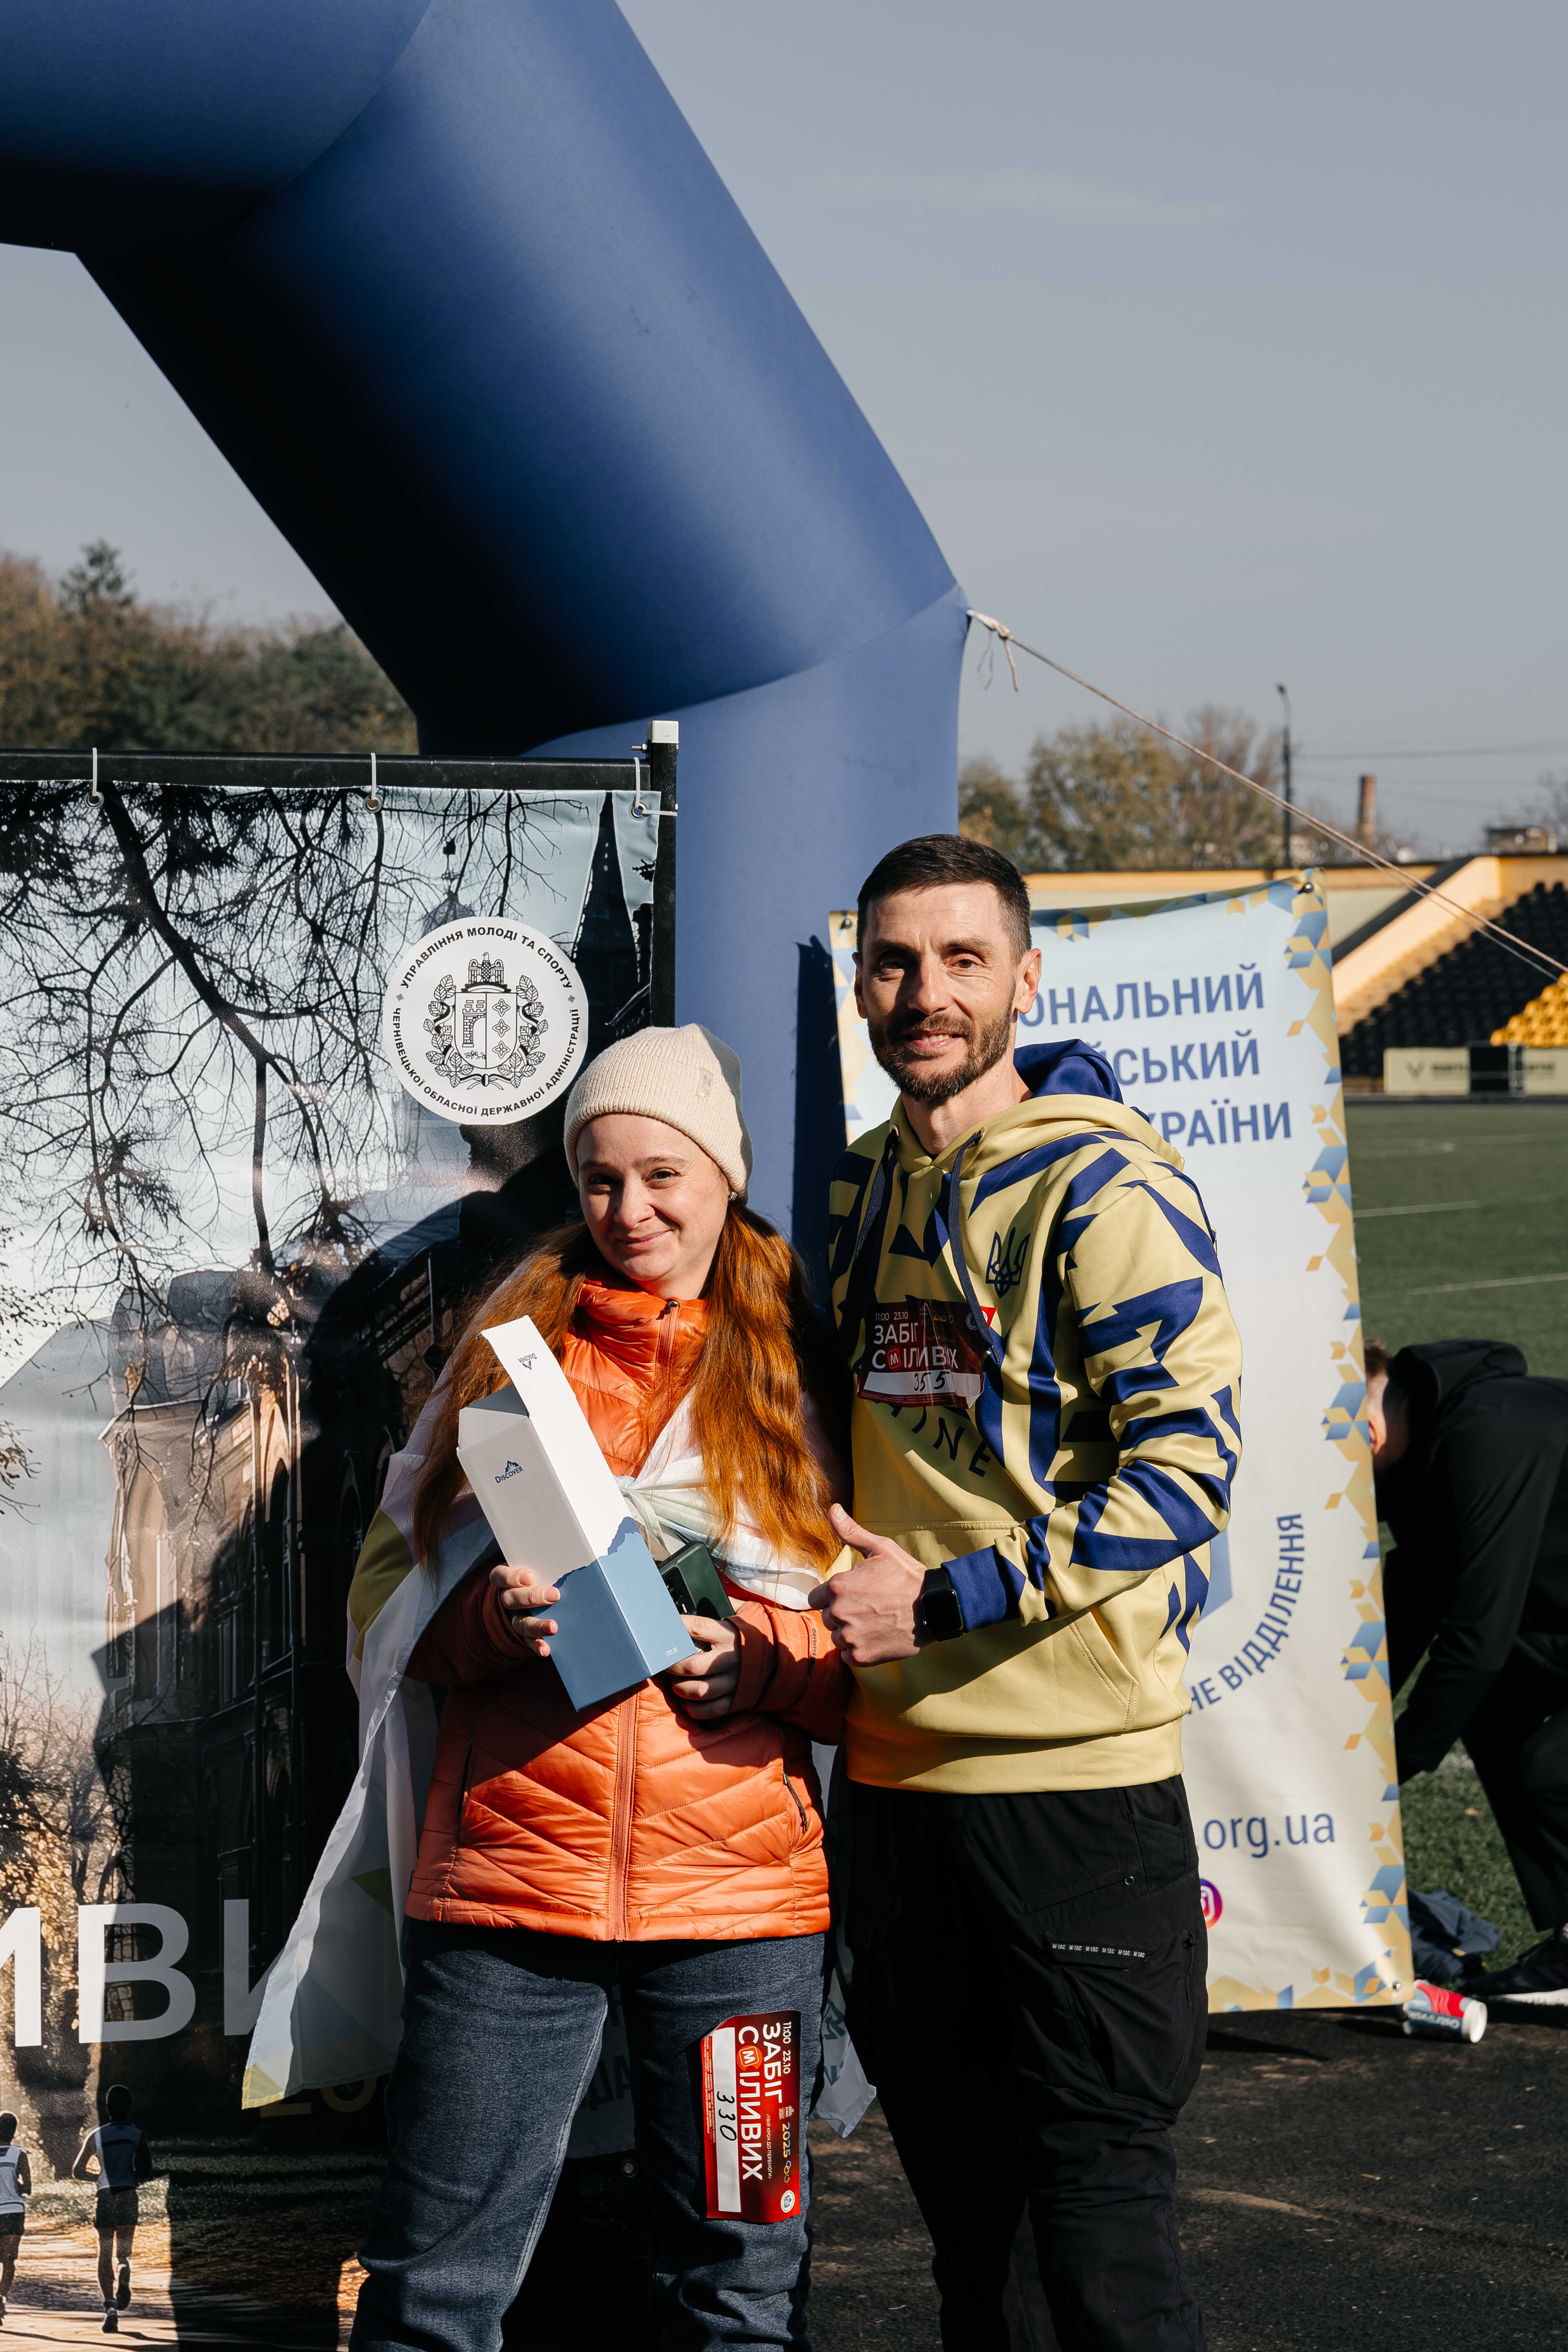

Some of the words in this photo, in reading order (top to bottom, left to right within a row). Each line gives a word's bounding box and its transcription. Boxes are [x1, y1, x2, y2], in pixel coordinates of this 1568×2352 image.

[400, 931, 464, 989] УПРАВЛІННЯ
[467, 927, 518, 941] МОЛОДІ
[521, 935, 536, 950] ТА
[537, 947, 573, 989] СПОРТУ
[1018, 963, 1264, 1027] ОНАЛЬНИЙ
[393, 1007, 425, 1087] ЧЕРНІВЕЦЬКОЇ
[424, 1086, 478, 1115] ОБЛАСНОЇ
[481, 1086, 546, 1116] ДЕРЖАВНОЇ
[545, 1009, 581, 1090] АДМІНІСТРАЦІЇ
[1087, 1029, 1260, 1085] СЬКИЙ
[1149, 1098, 1291, 1146] РАЇНИ
[874, 1323, 918, 1345] ЗАБІГ
[893, 1311, 908, 1320] 23.10
[1187, 1677, 1222, 1715] НЕ
[1218, 1513, 1305, 1691] ВІДДІЛЕННЯ
[1196, 1813, 1335, 1858] org.ua
[783, 2022, 791, 2044] 11:00
[762, 2023, 782, 2103] ЗАБІГ
[717, 2091, 737, 2141] 330
[738, 2026, 763, 2180] СМІЛИВИХ
[782, 2122, 791, 2158] 2025
